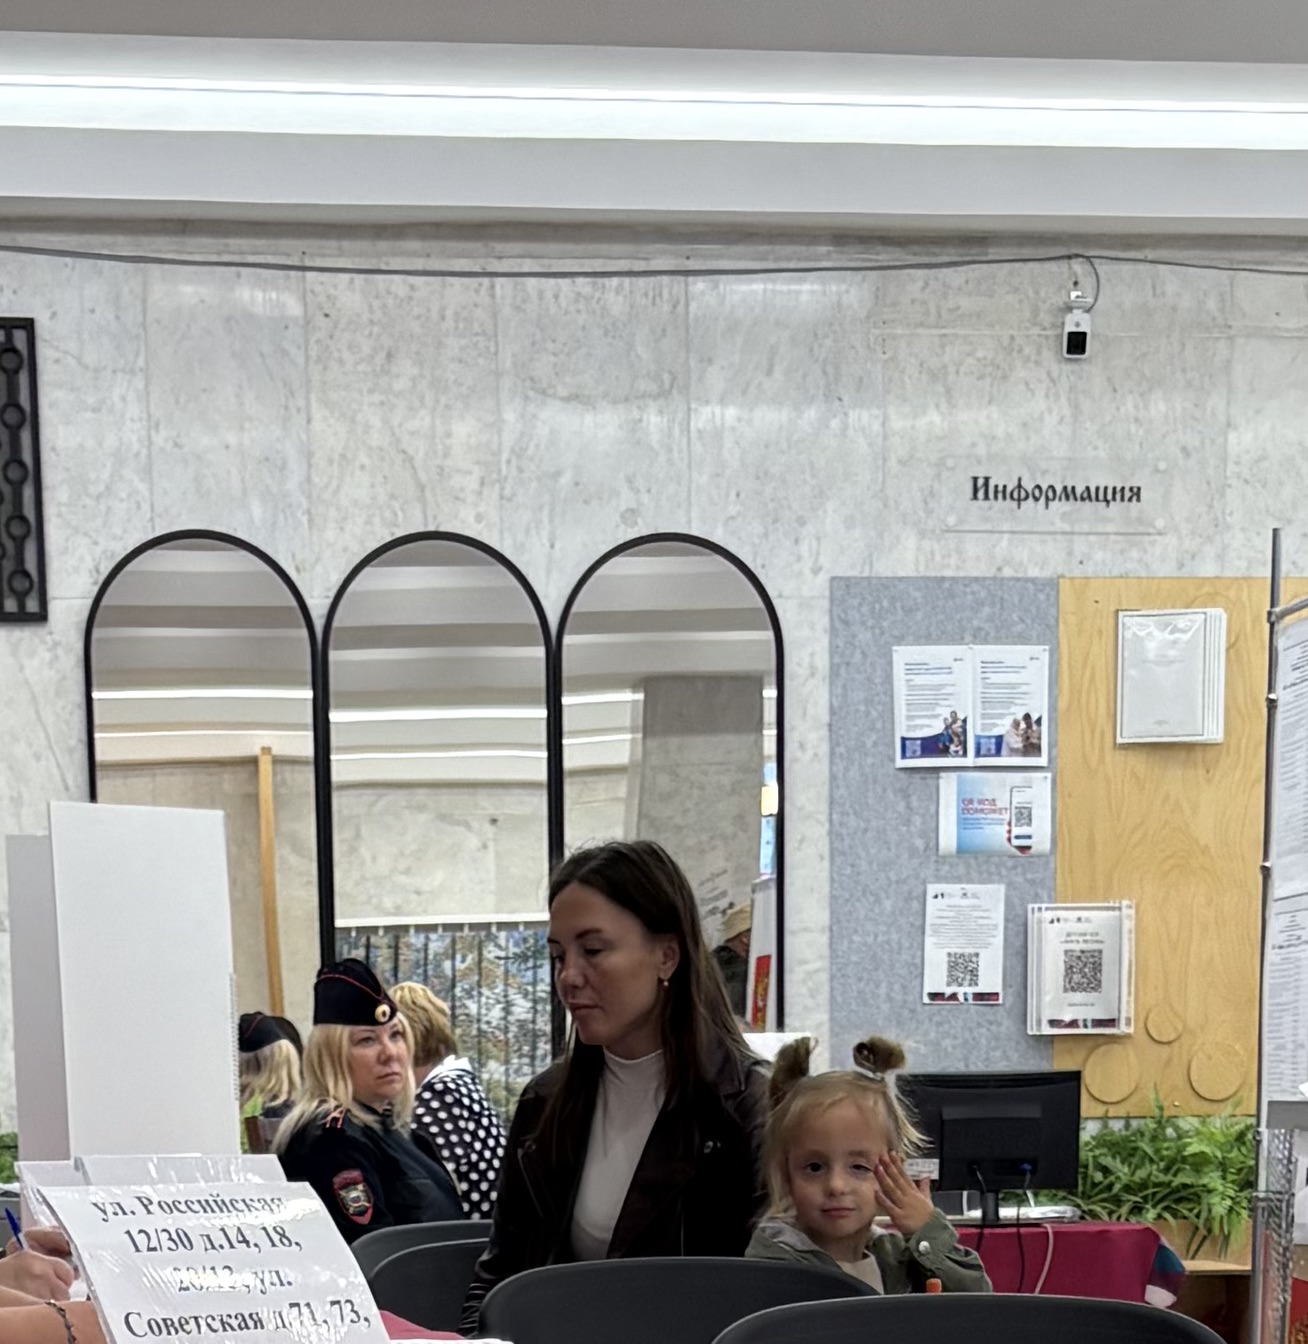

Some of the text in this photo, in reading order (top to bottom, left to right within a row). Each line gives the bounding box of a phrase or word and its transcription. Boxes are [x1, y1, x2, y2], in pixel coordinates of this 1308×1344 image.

[970, 476, 1142, 510] Информация
[91, 1193, 287, 1222] ул. Российская
[124, 1225, 303, 1254] 12/30 д.14, 18,
[253, 1269, 294, 1295] ул.
[123, 1311, 265, 1337] Советская
[329, 1299, 371, 1329] 73,
